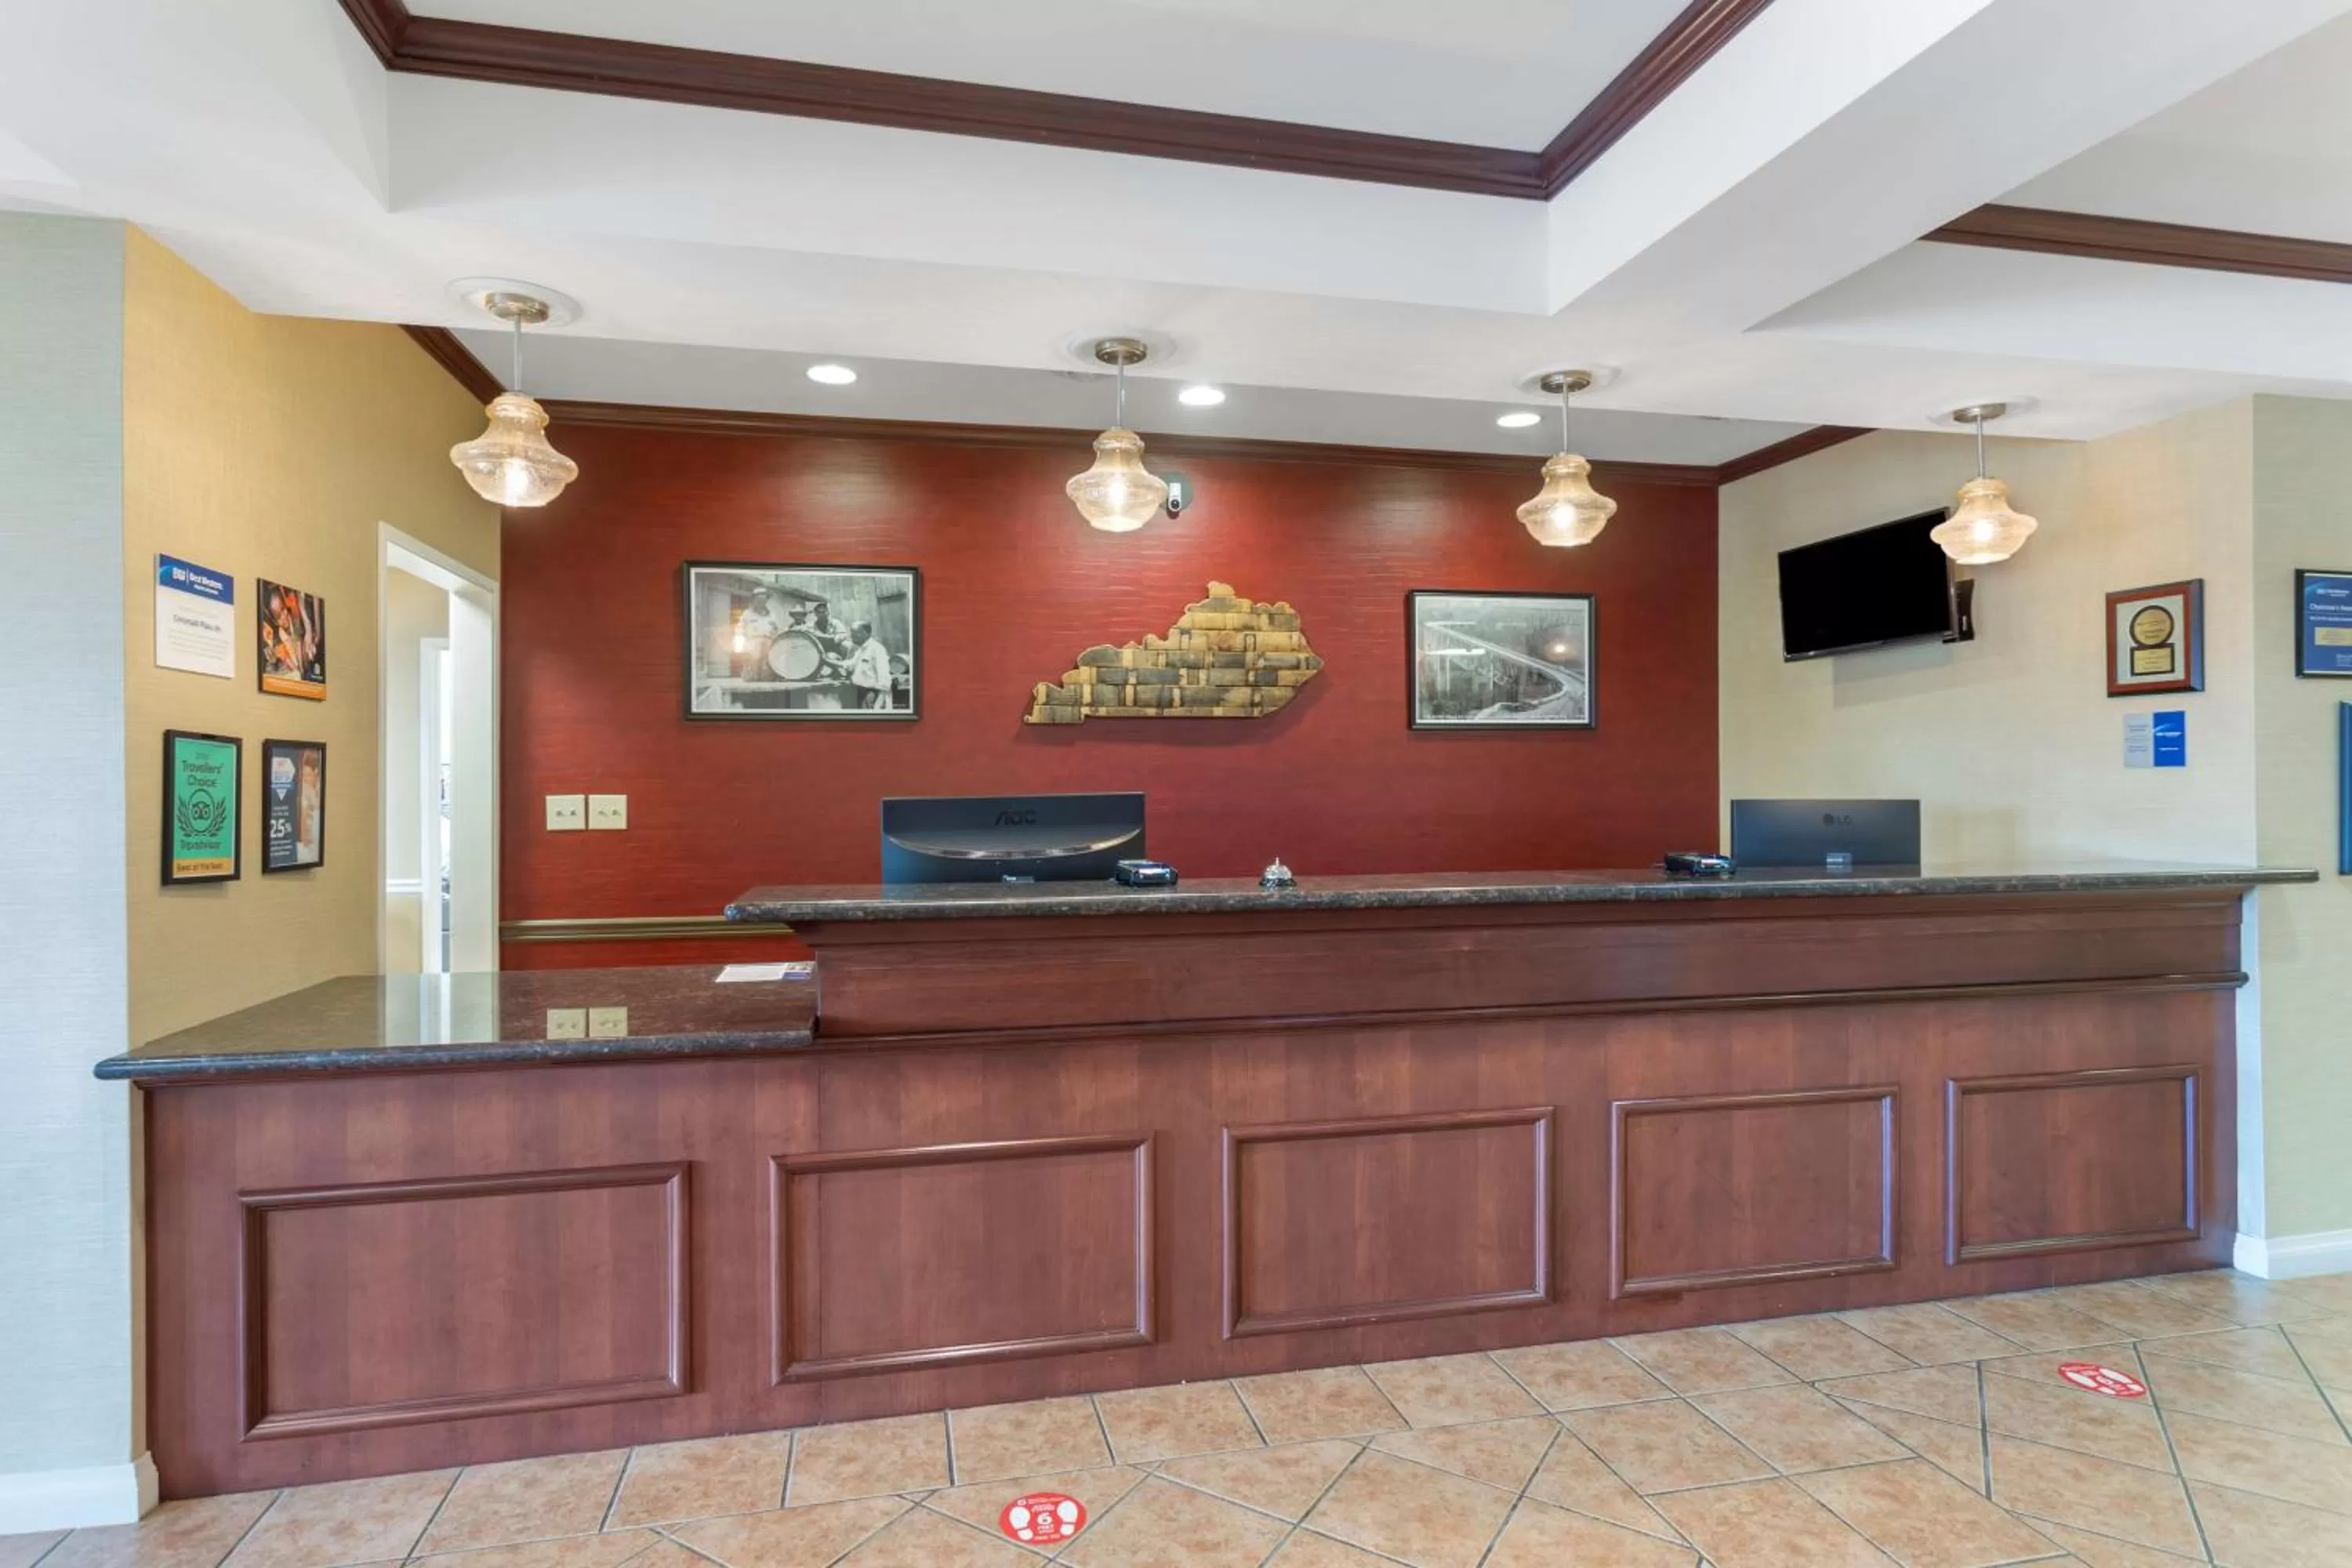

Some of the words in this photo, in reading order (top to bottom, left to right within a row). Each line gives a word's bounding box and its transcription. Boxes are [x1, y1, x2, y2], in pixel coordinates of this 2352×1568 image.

[187, 775, 218, 787] Choice
[995, 810, 1036, 826] AOC
[1837, 815, 1852, 826] LG
[1037, 1512, 1052, 1525] 6
